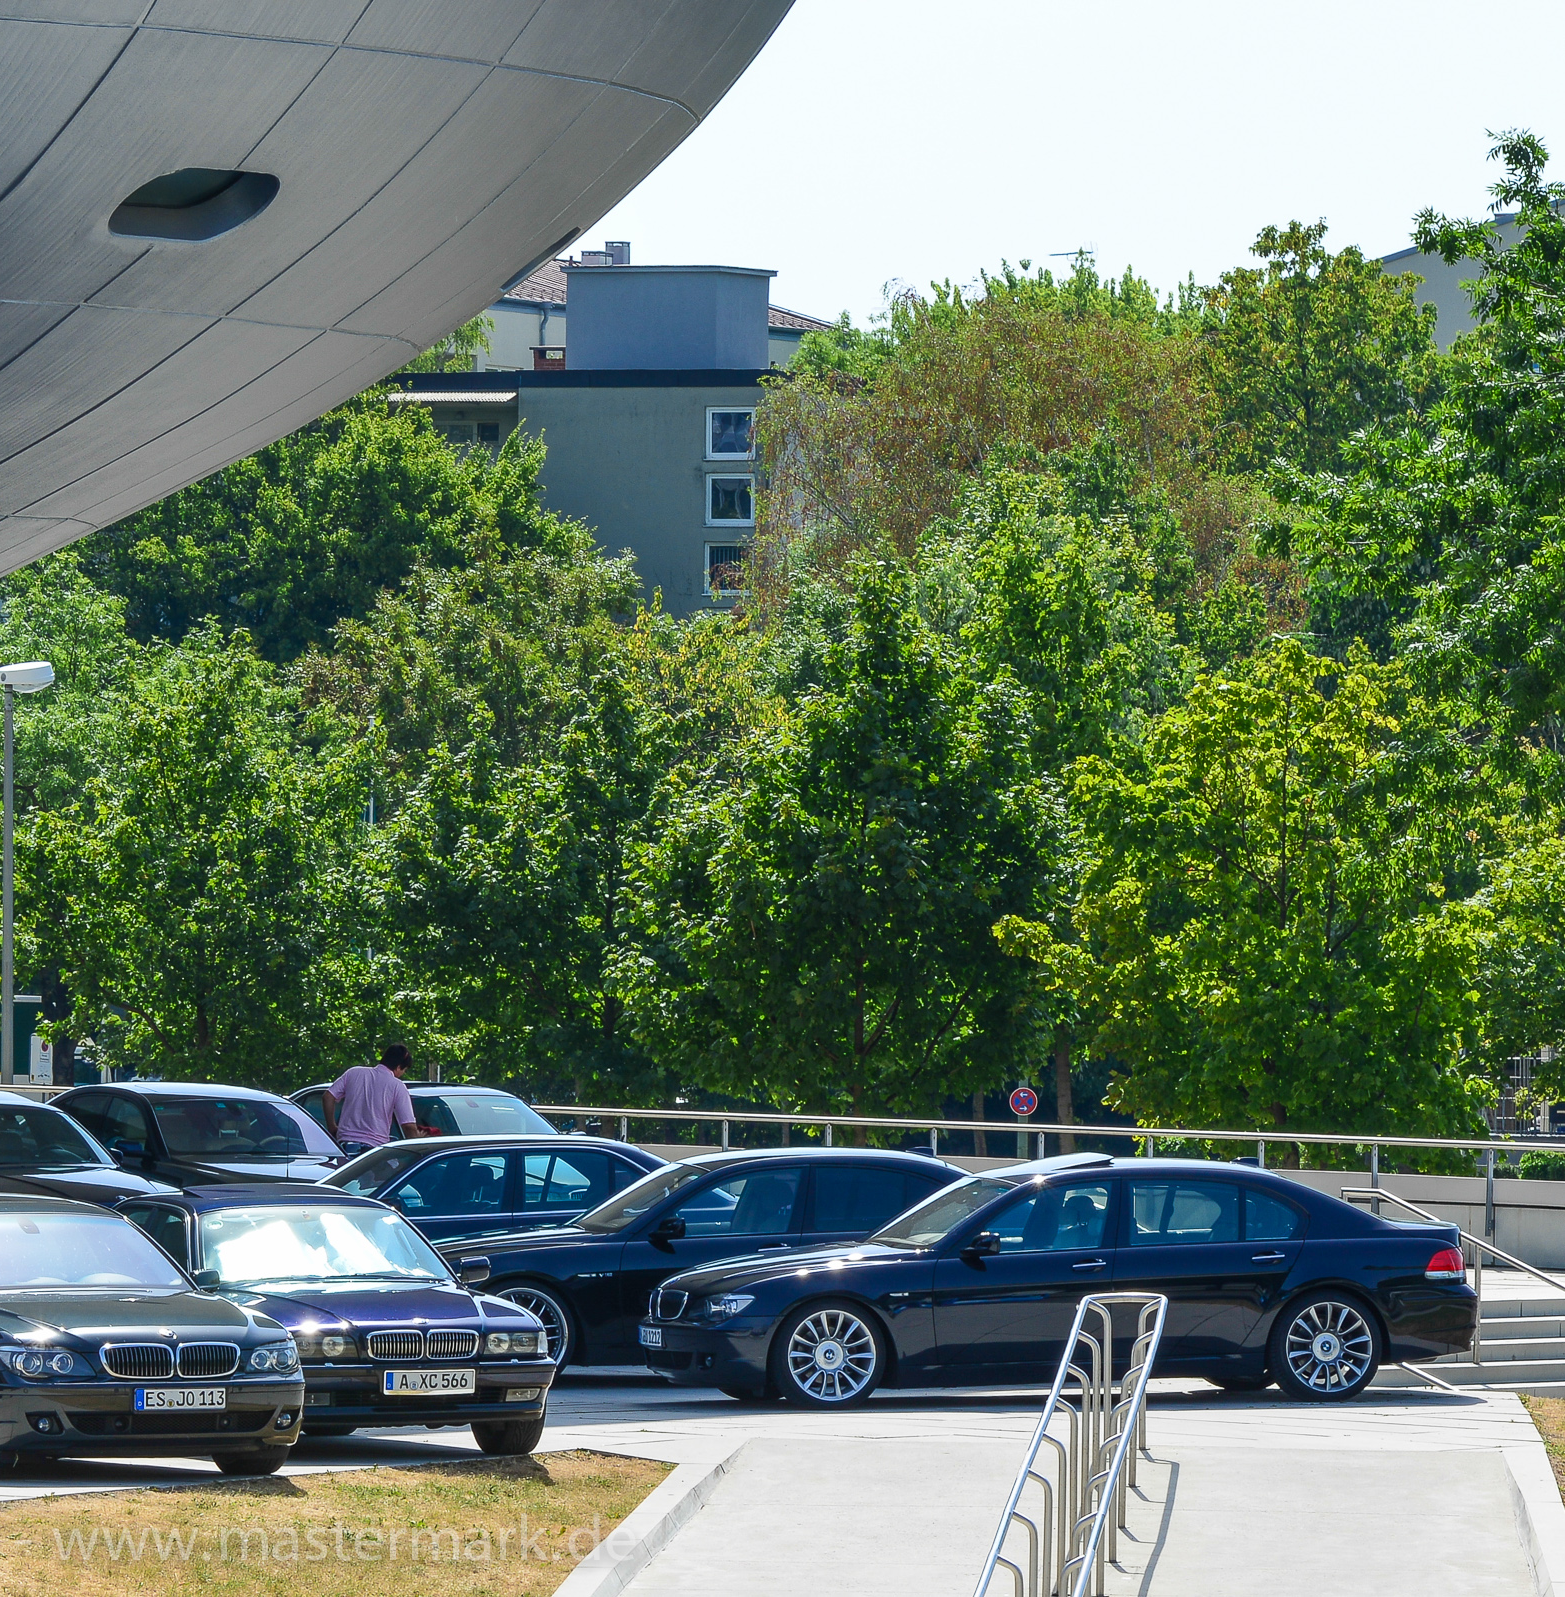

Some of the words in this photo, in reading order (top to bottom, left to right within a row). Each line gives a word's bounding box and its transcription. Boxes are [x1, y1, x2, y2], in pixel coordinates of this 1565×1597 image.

[399, 1374, 409, 1389] A
[419, 1373, 438, 1389] XC
[441, 1373, 468, 1389] 566
[145, 1391, 166, 1407] ES
[176, 1391, 195, 1407] JO
[198, 1390, 225, 1406] 113
